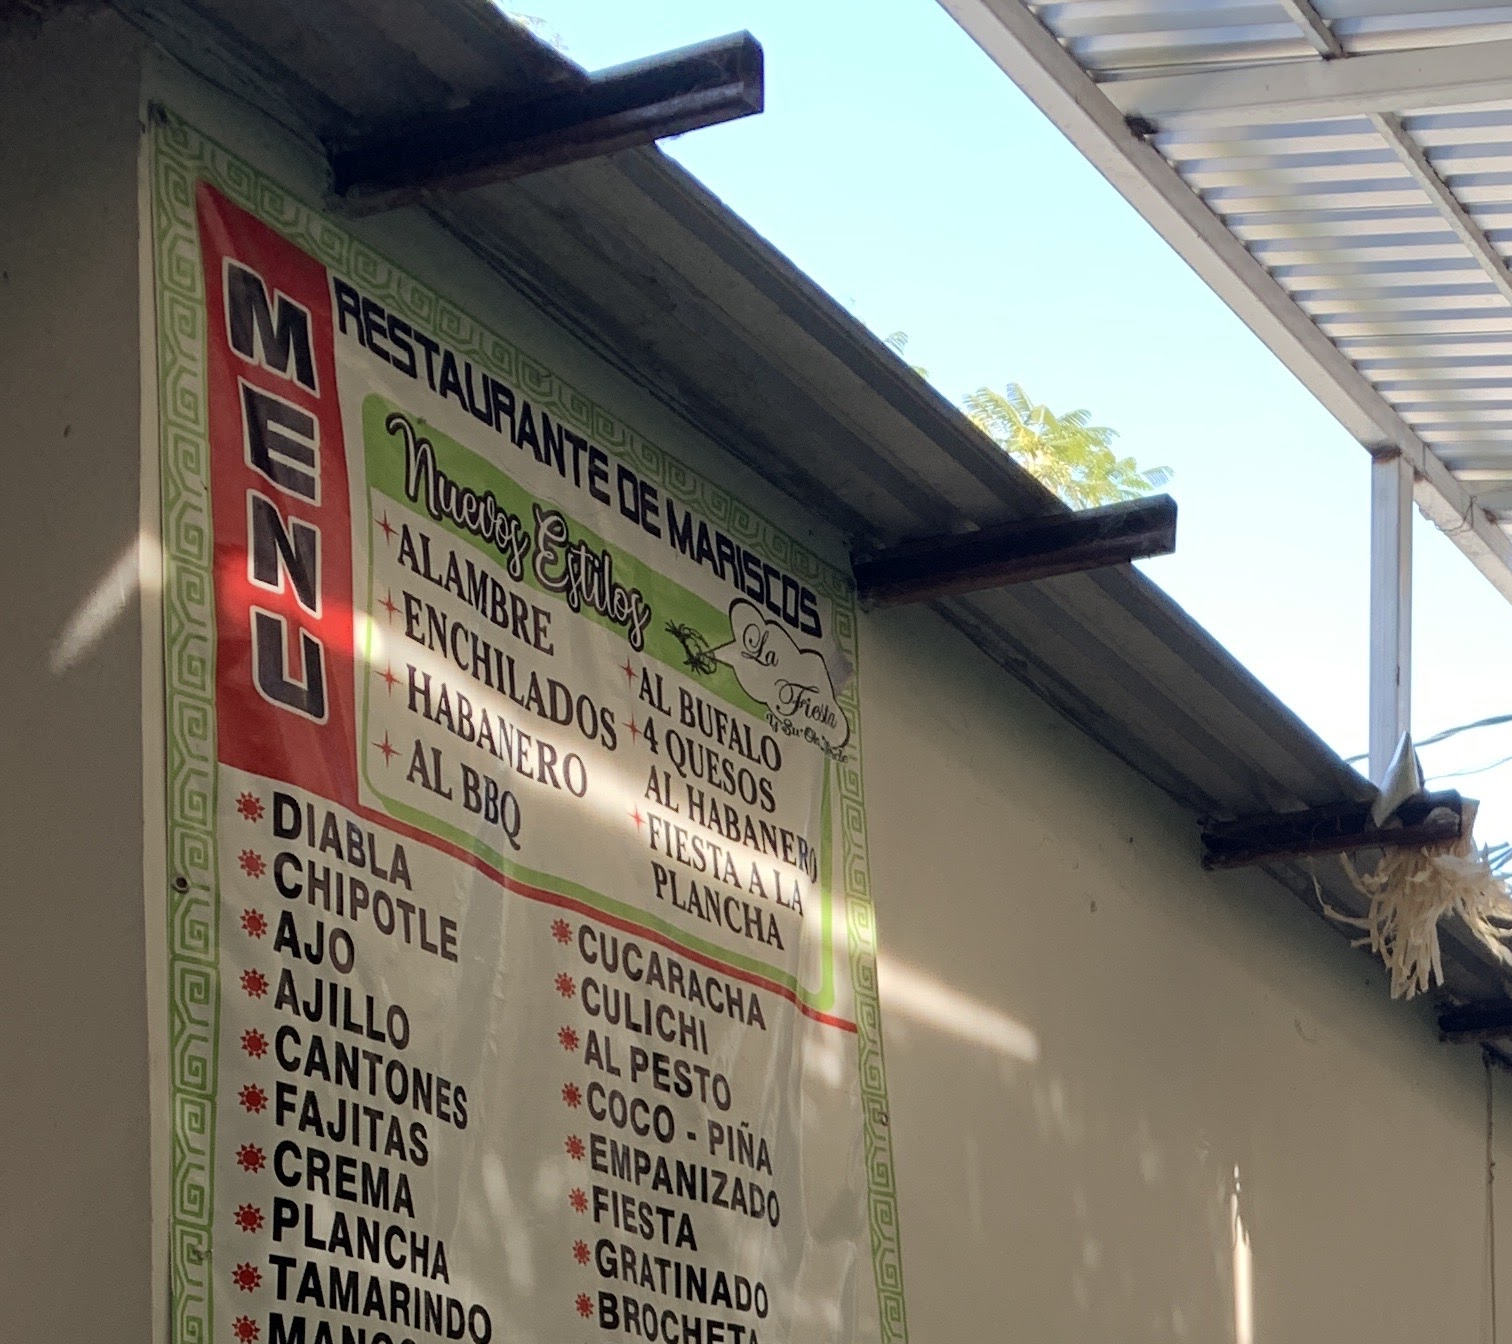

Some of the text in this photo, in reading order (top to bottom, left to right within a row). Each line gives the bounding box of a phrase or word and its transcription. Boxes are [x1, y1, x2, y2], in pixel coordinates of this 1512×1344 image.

[223, 256, 329, 724] MENU
[333, 276, 822, 639] RESTAURANTE DE MARISCOS
[386, 413, 651, 652] Nuevos Estilos
[399, 523, 554, 656] ALAMBRE
[402, 590, 618, 751] ENCHILADOS
[741, 623, 778, 667] La
[406, 663, 587, 798] HABANERO
[639, 667, 671, 717] AL
[679, 686, 782, 772] BUFALO
[774, 679, 838, 729] Fiesta
[406, 739, 521, 850] AL BBQ
[643, 715, 659, 754] 4
[666, 730, 776, 813] QUESOS
[273, 791, 412, 891] DIABLA
[645, 765, 818, 884] AL HABANERO
[647, 811, 804, 917] FIESTA A LA
[273, 851, 458, 963] CHIPOTLE
[273, 909, 355, 974] AJO
[651, 861, 784, 951] PLANCHA
[274, 967, 410, 1050] AJILLO
[578, 924, 767, 1031] CUCARACHA
[581, 976, 708, 1055] CULICHI
[275, 1024, 469, 1130] CANTONES
[584, 1029, 732, 1112] AL PESTO
[275, 1080, 429, 1167] FAJITAS
[587, 1081, 676, 1144] COCO
[707, 1118, 773, 1176] PIÑA
[273, 1140, 415, 1219] CREMA
[589, 1132, 781, 1228] EMPANIZADO
[592, 1185, 698, 1251] FIESTA
[272, 1196, 450, 1285] PLANCHA
[594, 1238, 769, 1319] GRATINADO
